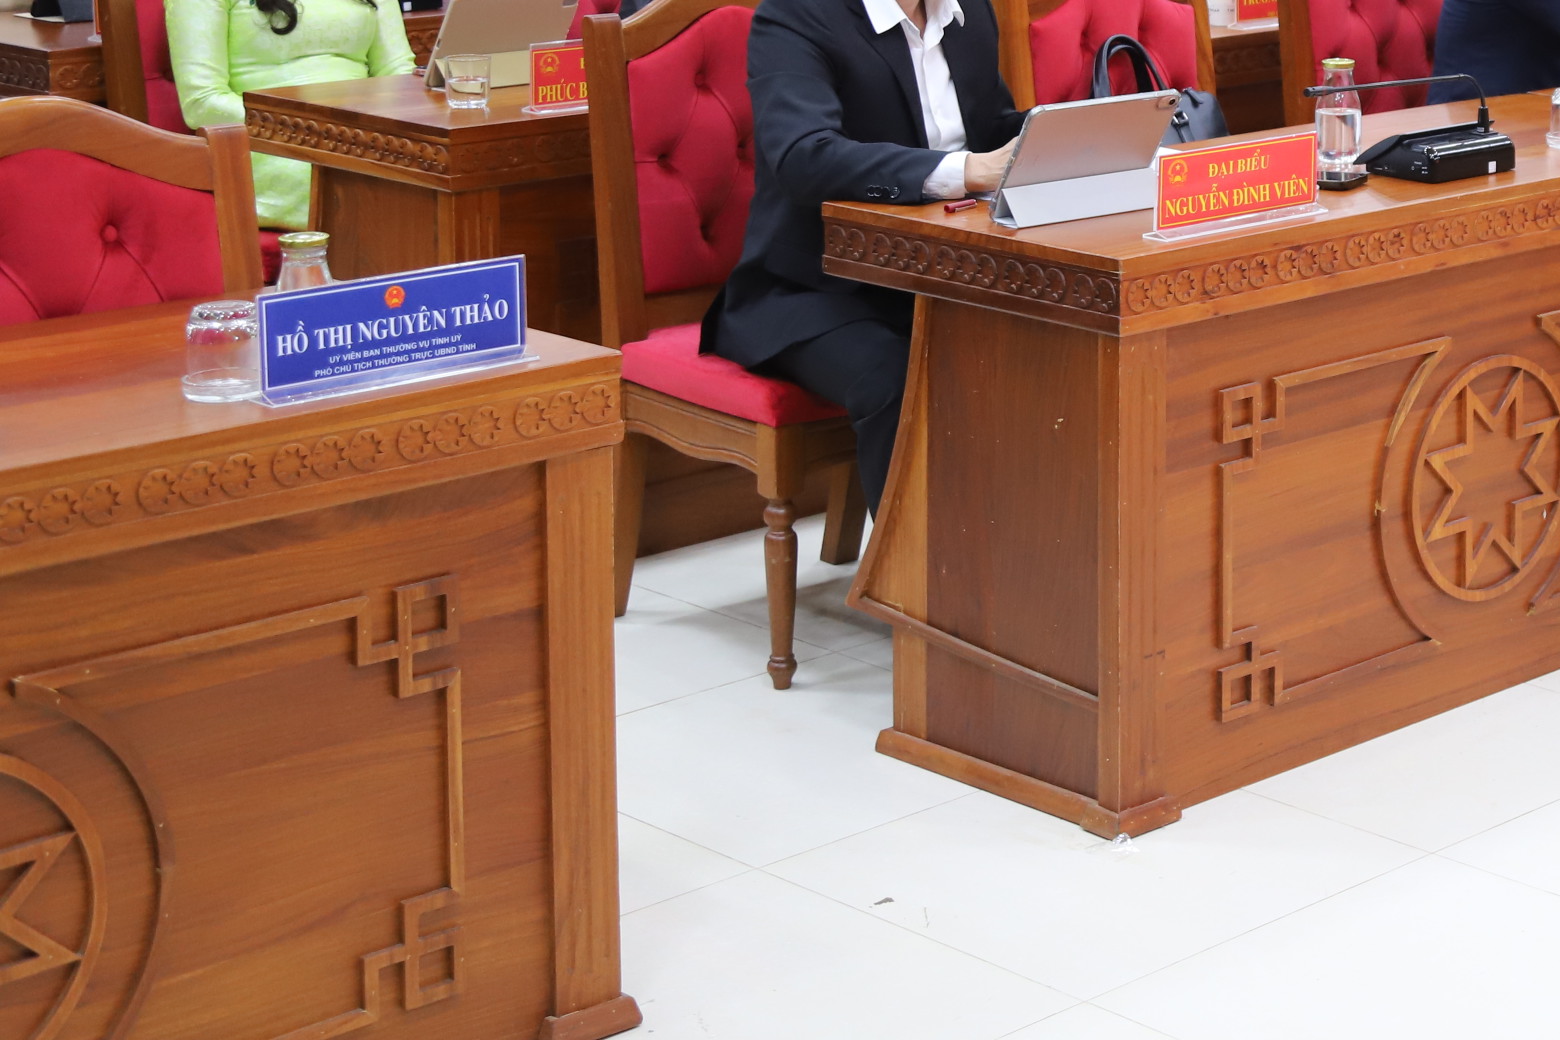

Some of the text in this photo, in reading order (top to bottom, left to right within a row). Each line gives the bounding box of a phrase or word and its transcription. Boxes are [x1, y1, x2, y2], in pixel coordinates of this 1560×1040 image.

[538, 78, 576, 103] PHÚC
[1208, 148, 1270, 179] ĐẠI BIỂU
[1165, 173, 1309, 218] NGUYỄN ĐÌNH VIÊN
[276, 293, 509, 357] HỒ THỊ NGUYÊN THẢO
[314, 342, 477, 378] PHÓ CHỦ TỊCH THƯỜNG TRỰC UBND TỈNH
[342, 350, 362, 361] VIÊN
[363, 348, 381, 358] BAN
[382, 342, 418, 355] THƯỜNG
[419, 340, 430, 349] VỤ
[431, 334, 450, 345] TỈNH
